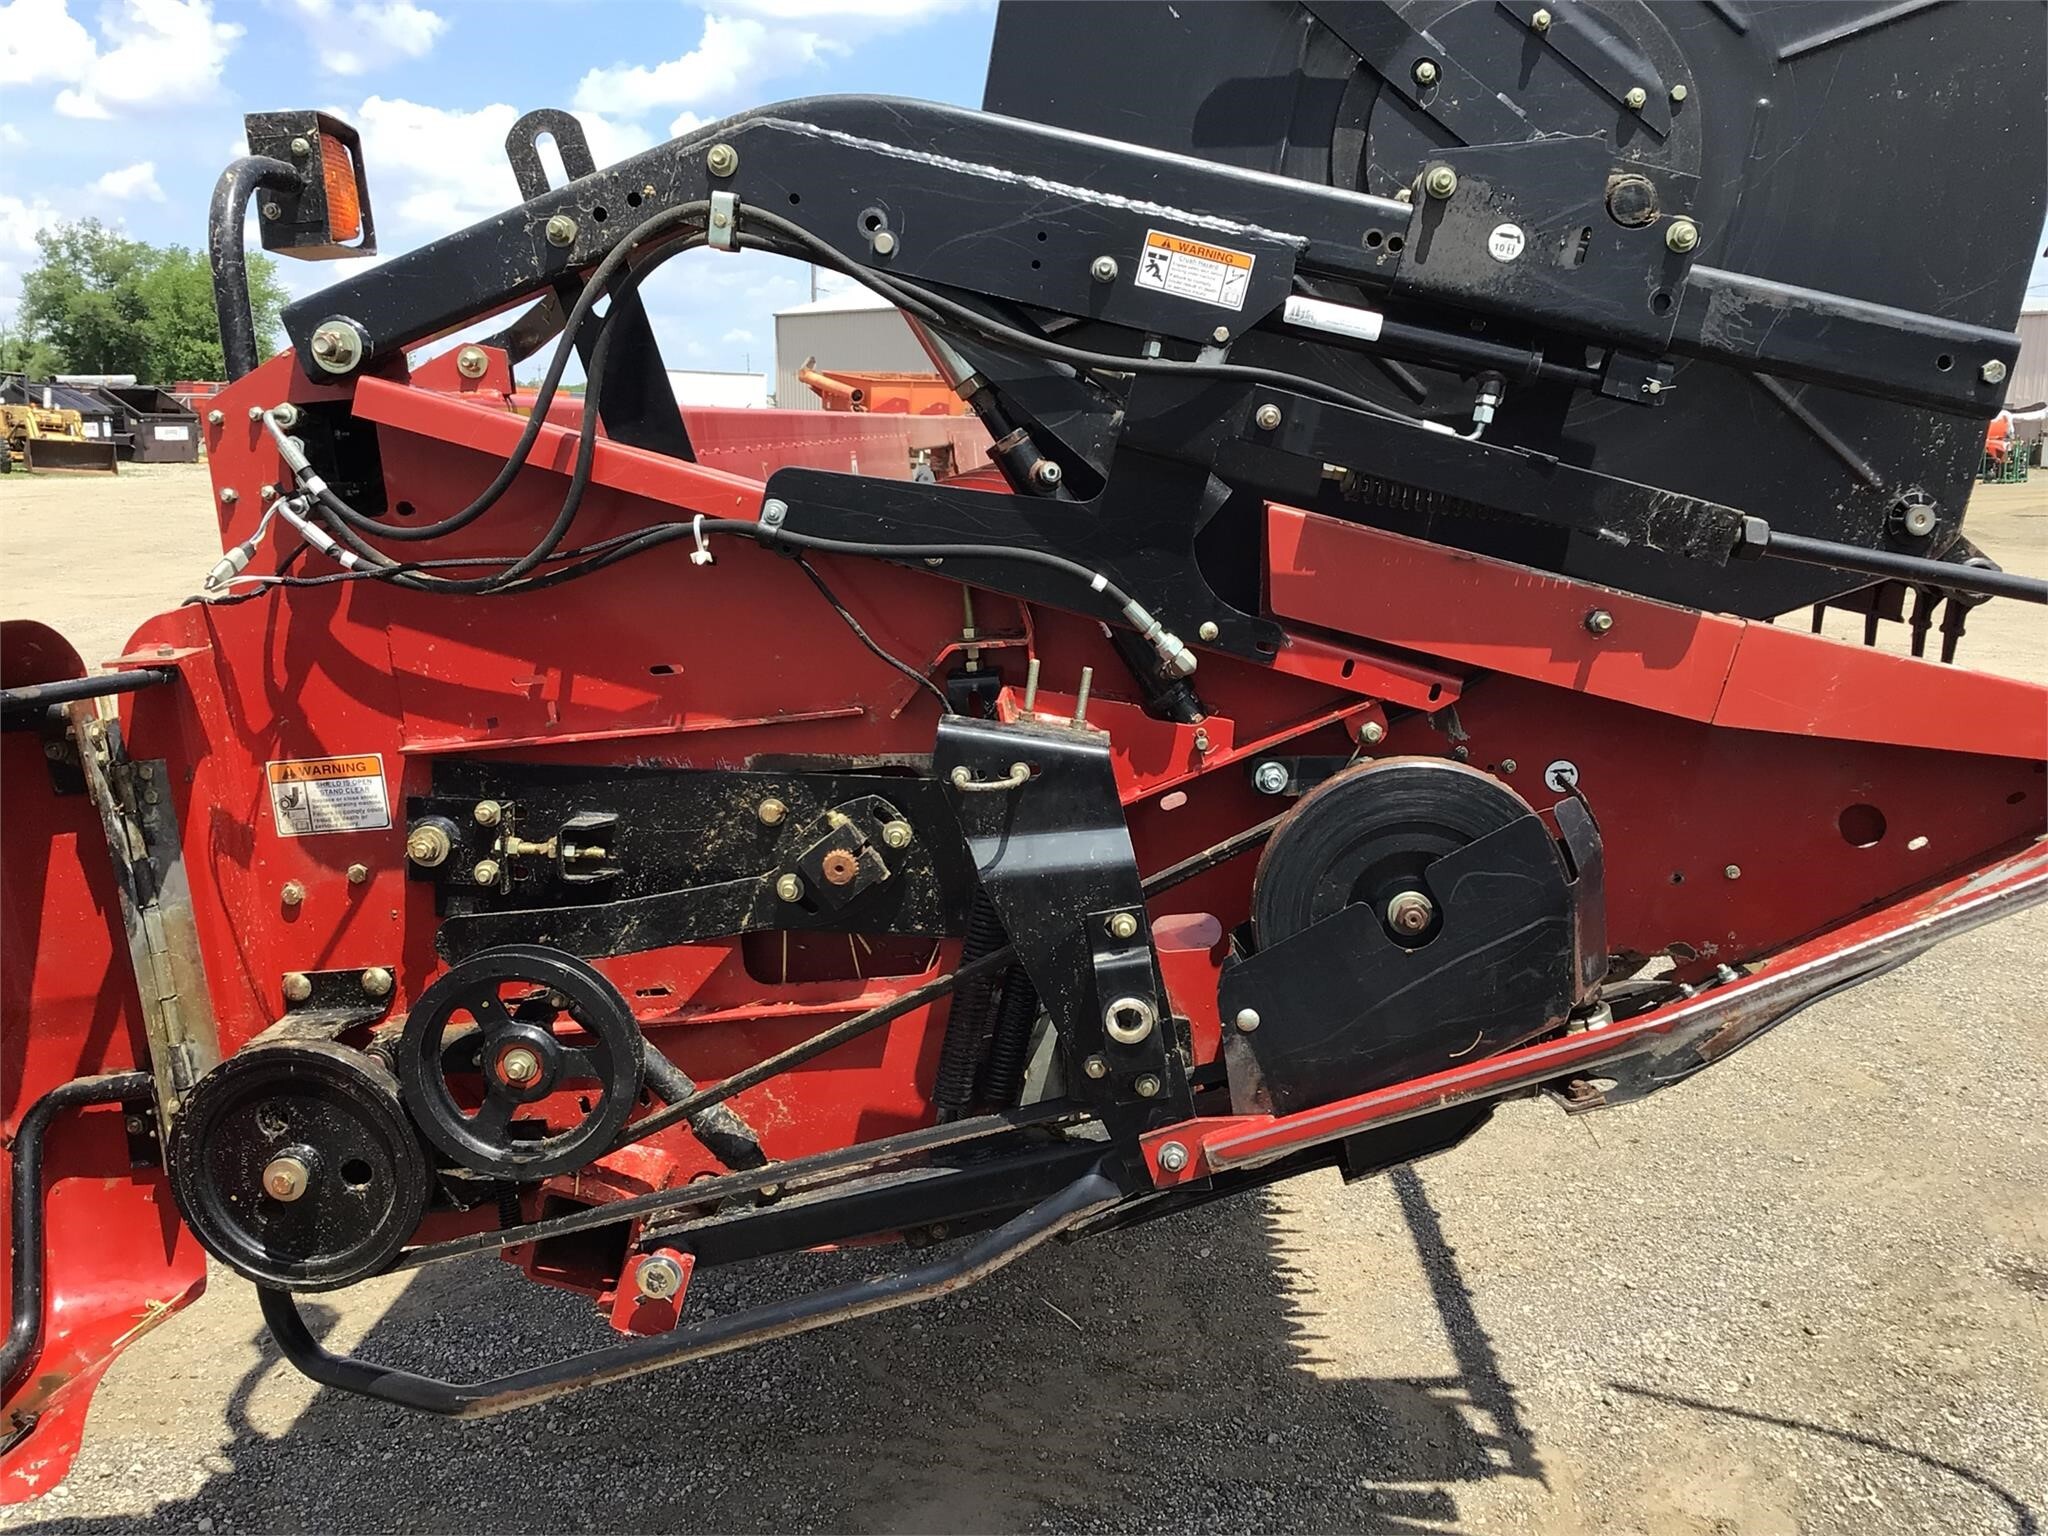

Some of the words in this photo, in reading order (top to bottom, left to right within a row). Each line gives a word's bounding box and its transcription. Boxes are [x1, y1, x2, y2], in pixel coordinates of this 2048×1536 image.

[1179, 242, 1234, 264] WARNING
[1179, 255, 1196, 264] Crush
[299, 762, 366, 777] WARNING
[315, 780, 342, 788] SHIELD
[352, 778, 372, 786] OPEN
[320, 788, 343, 796] STAND
[345, 786, 370, 794] CLEAR
